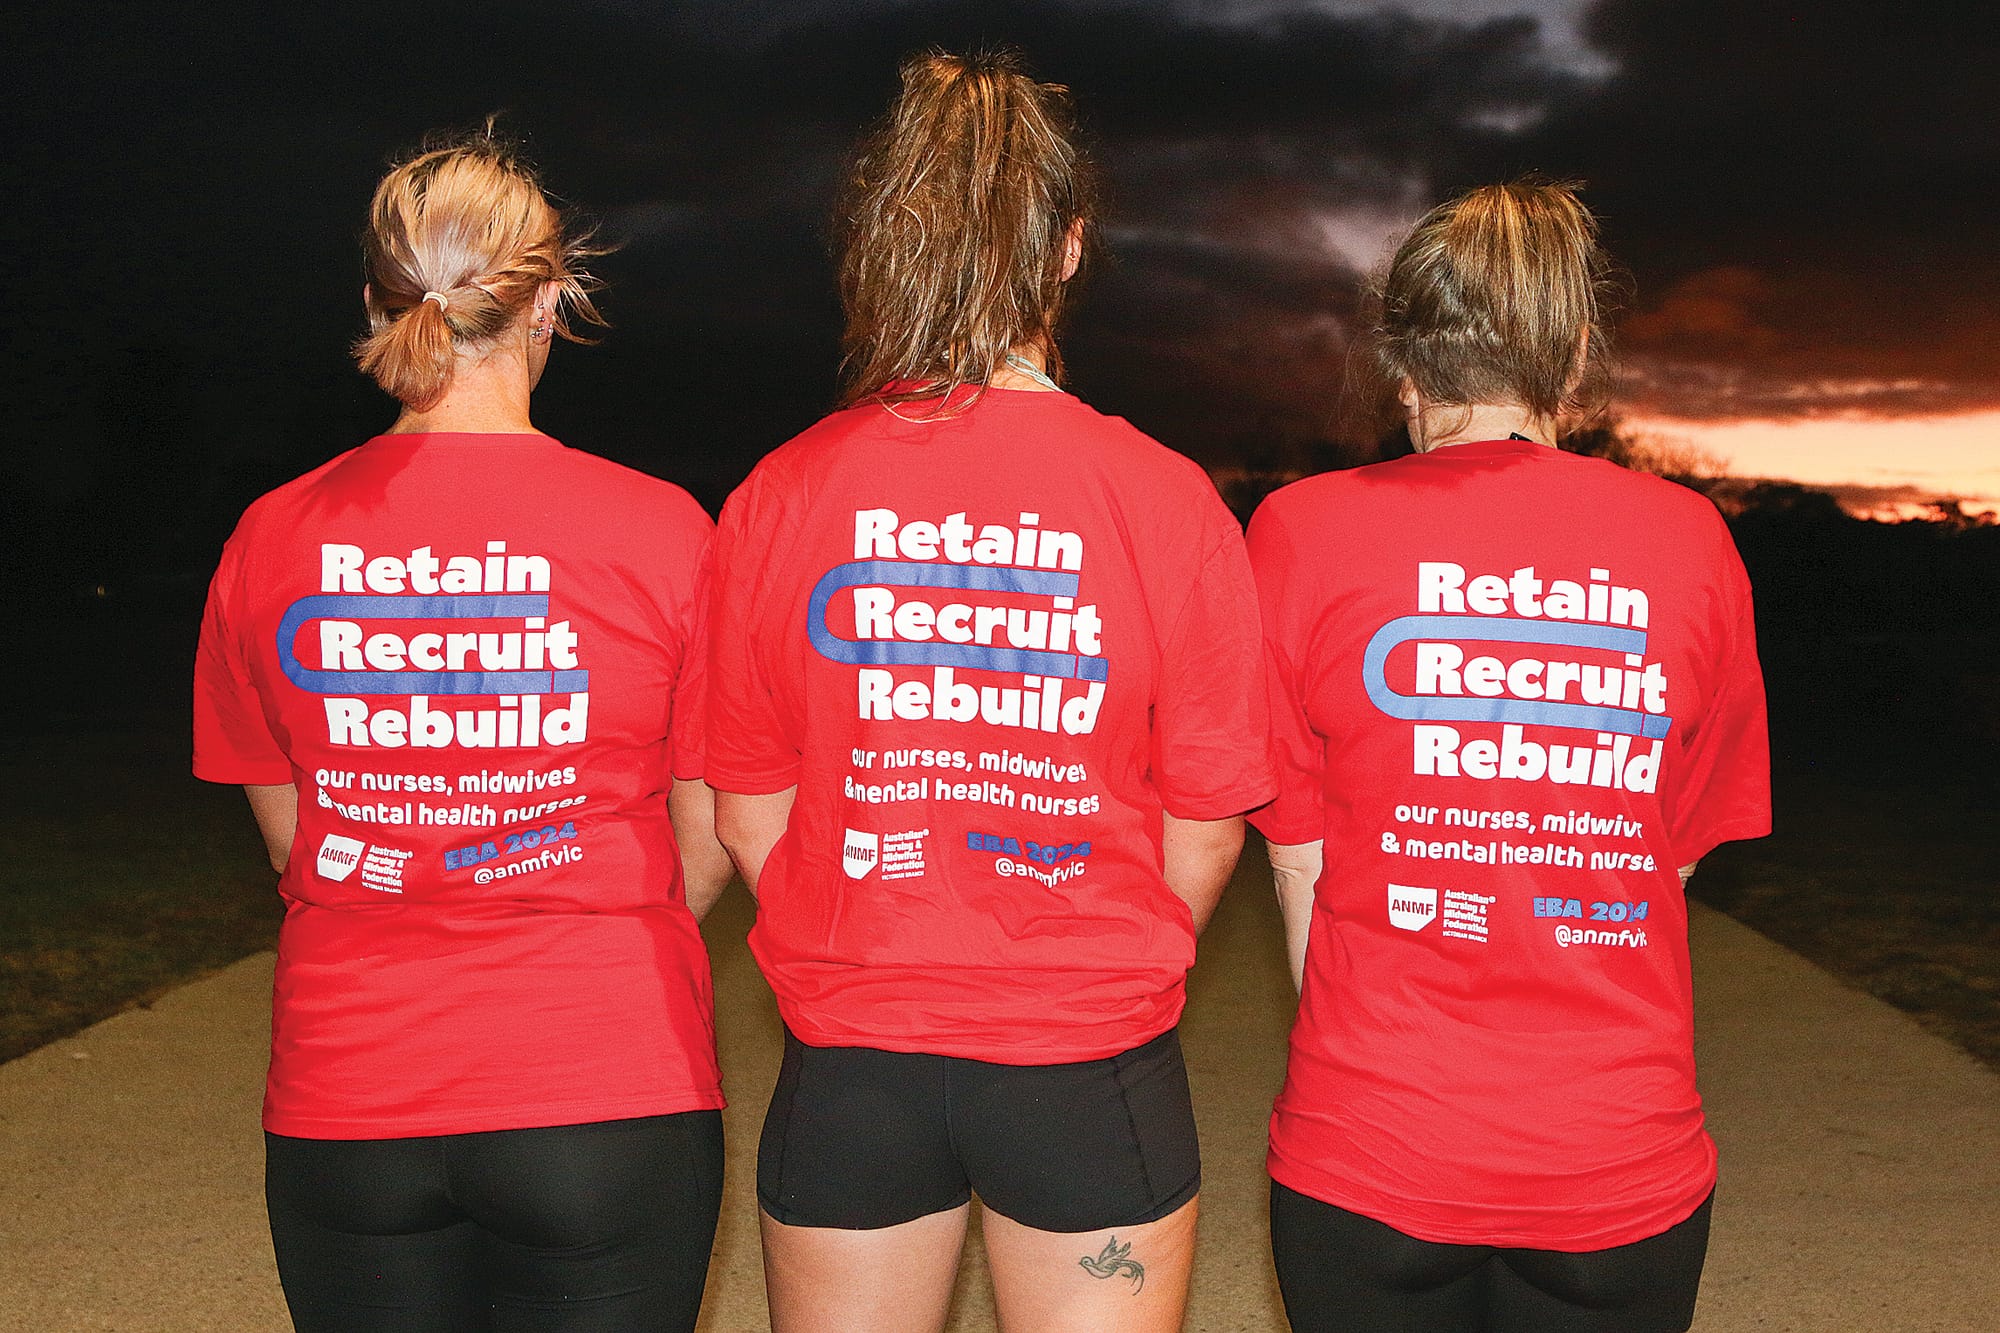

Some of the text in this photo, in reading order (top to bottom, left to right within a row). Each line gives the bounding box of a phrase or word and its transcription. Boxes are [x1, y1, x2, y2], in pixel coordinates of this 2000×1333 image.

[854, 508, 1084, 571] Retain
[321, 541, 550, 594] Retain
[1418, 561, 1649, 629] Retain
[853, 587, 1102, 656] Recruit
[320, 617, 579, 671] Recruit
[1415, 642, 1667, 714] Recruit
[323, 692, 589, 748] Rebuild
[858, 666, 1107, 735] Rebuild
[852, 748, 877, 769] our
[883, 748, 973, 772] nurses,
[1413, 724, 1664, 794] Rebuild
[315, 766, 577, 797] our nurses, midwives
[844, 776, 1100, 816] & mental health nurses
[317, 787, 333, 809] &
[419, 803, 497, 827] health
[503, 795, 587, 825] nurses
[1394, 804, 1439, 825] our
[1444, 807, 1536, 834] nurses,
[320, 847, 358, 866] ANMF
[444, 821, 578, 871] EBA 2024
[474, 845, 583, 884] @anmfvic
[845, 844, 876, 862] ANMF
[882, 860, 925, 872] Federation
[967, 831, 1092, 865] EBA 2024
[1380, 831, 1658, 872] & mental health nurse
[995, 857, 1085, 889] @anmfvic
[1391, 898, 1434, 916] ANMF
[1443, 919, 1489, 935] Federation
[1533, 896, 1582, 918] EBA
